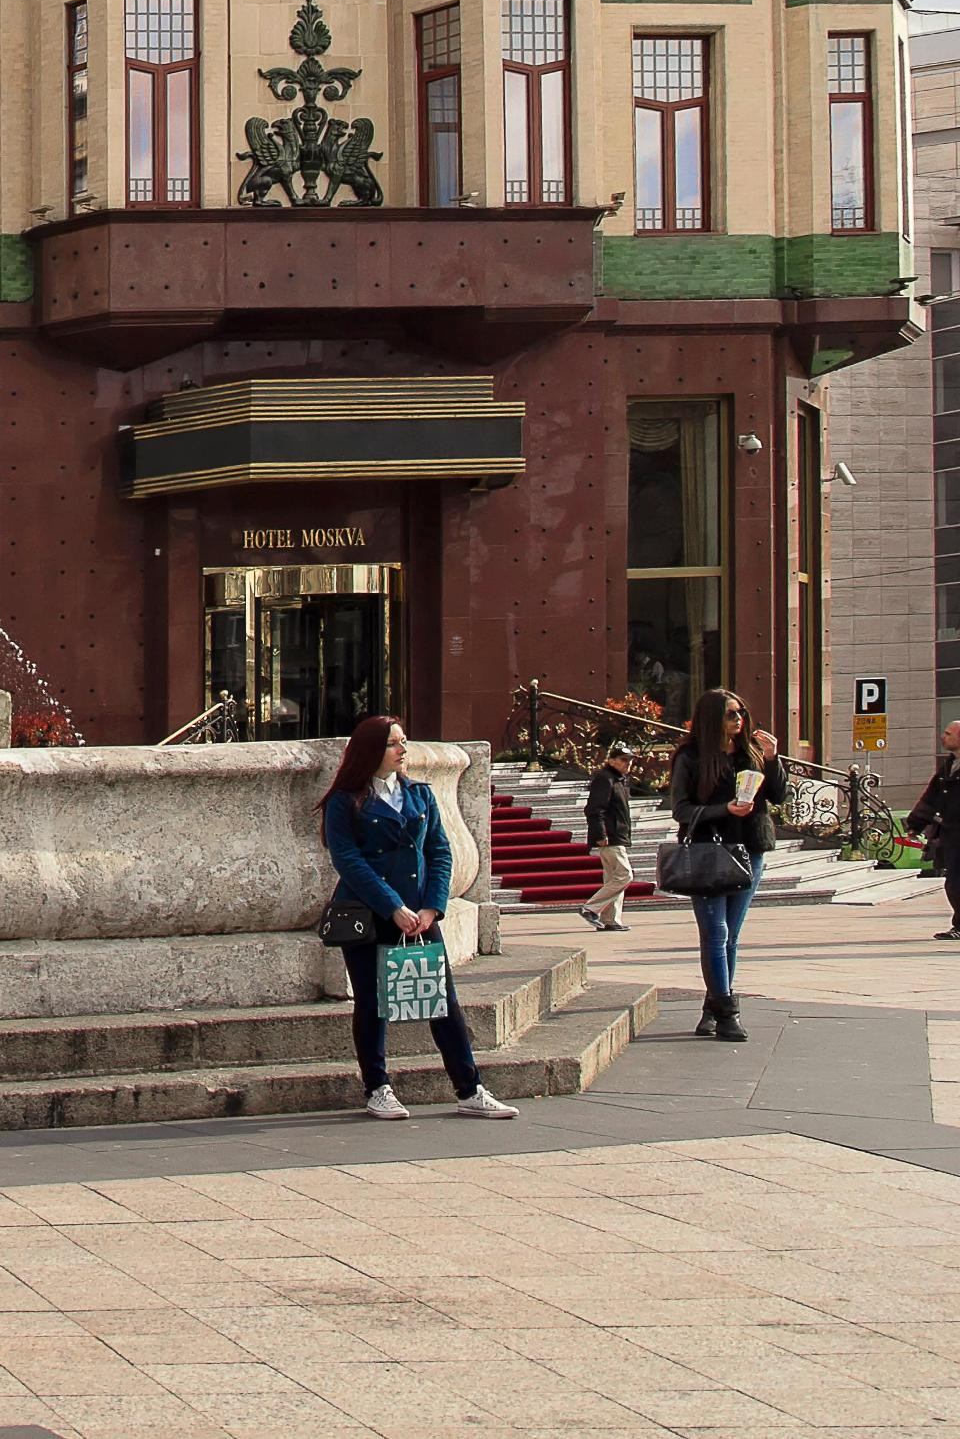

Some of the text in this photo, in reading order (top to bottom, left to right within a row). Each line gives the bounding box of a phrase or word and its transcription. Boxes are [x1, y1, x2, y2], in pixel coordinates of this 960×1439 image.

[242, 527, 366, 549] HOTEL MOSKVA
[862, 682, 880, 711] P
